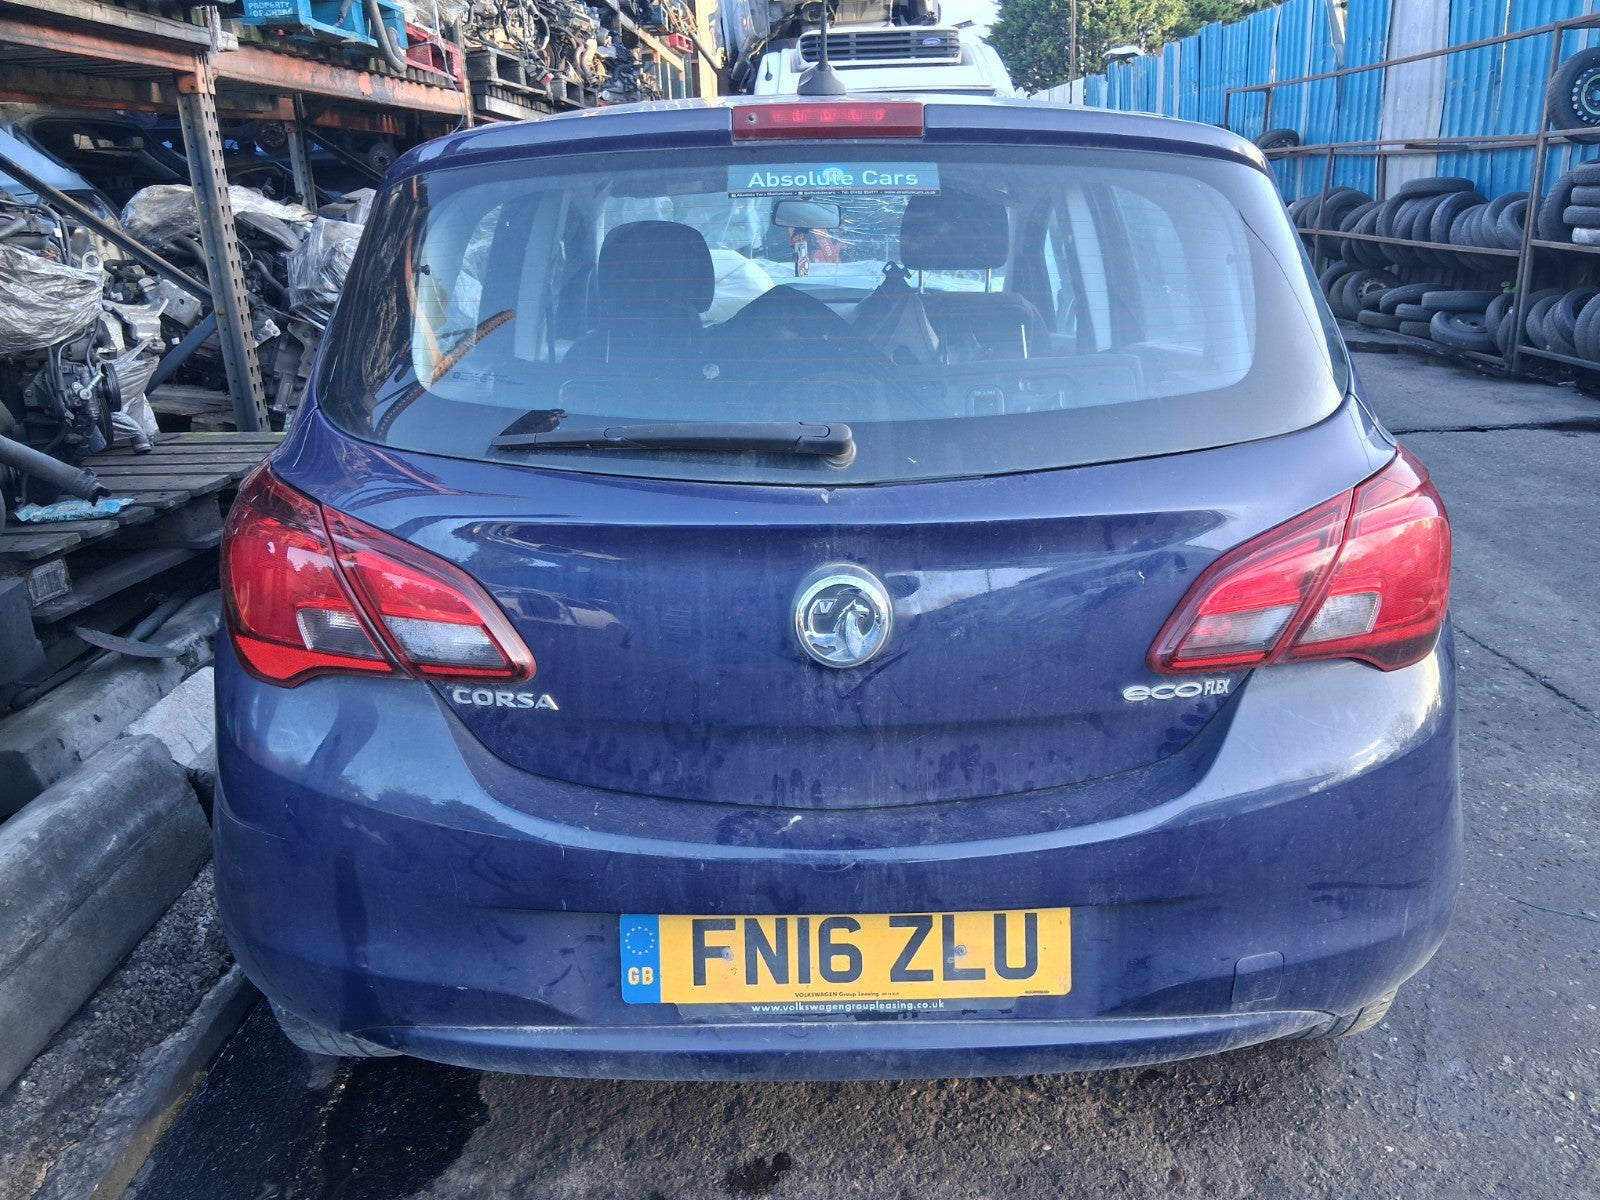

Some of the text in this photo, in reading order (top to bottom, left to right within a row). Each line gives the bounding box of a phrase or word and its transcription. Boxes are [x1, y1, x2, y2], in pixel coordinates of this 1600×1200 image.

[248, 1, 290, 9] PROPERTY
[747, 168, 919, 188] Absolute Cars
[452, 688, 560, 711] CORSA
[691, 912, 1039, 986] FN16 ZLU
[627, 966, 654, 986] GB
[751, 999, 945, 1013] www.volkswagengroupleasing.co.uk
